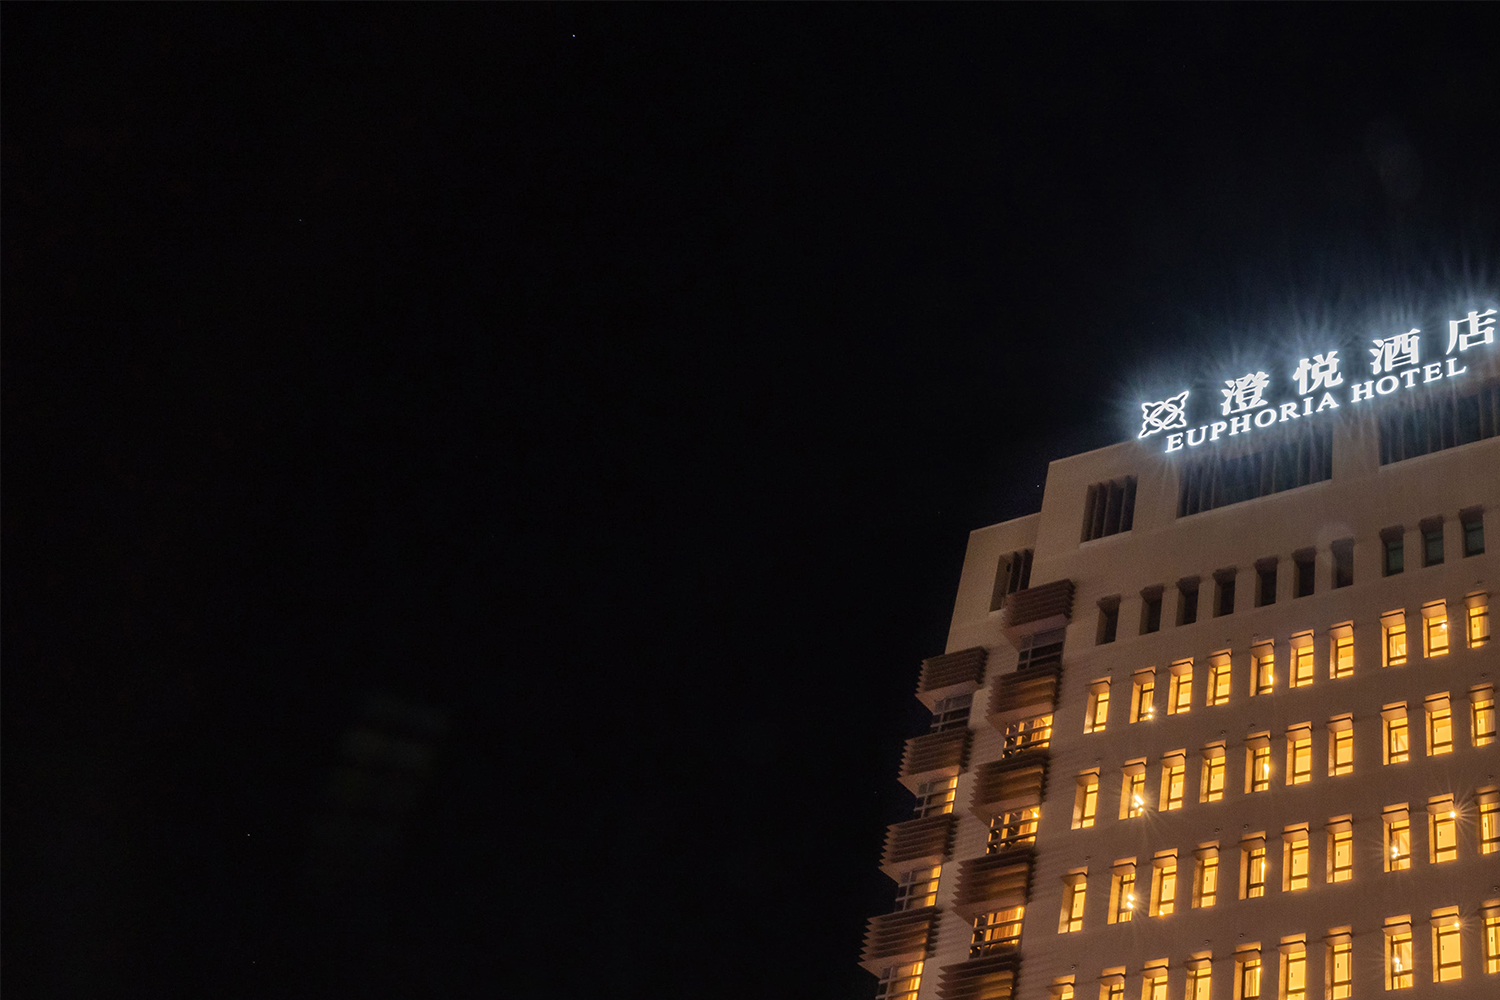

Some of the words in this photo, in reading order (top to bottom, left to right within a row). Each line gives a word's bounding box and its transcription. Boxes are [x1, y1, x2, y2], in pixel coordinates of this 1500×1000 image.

[1164, 391, 1340, 454] EUPHORIA
[1350, 357, 1467, 403] HOTEL
[1220, 309, 1498, 415] 澄悅酒店
